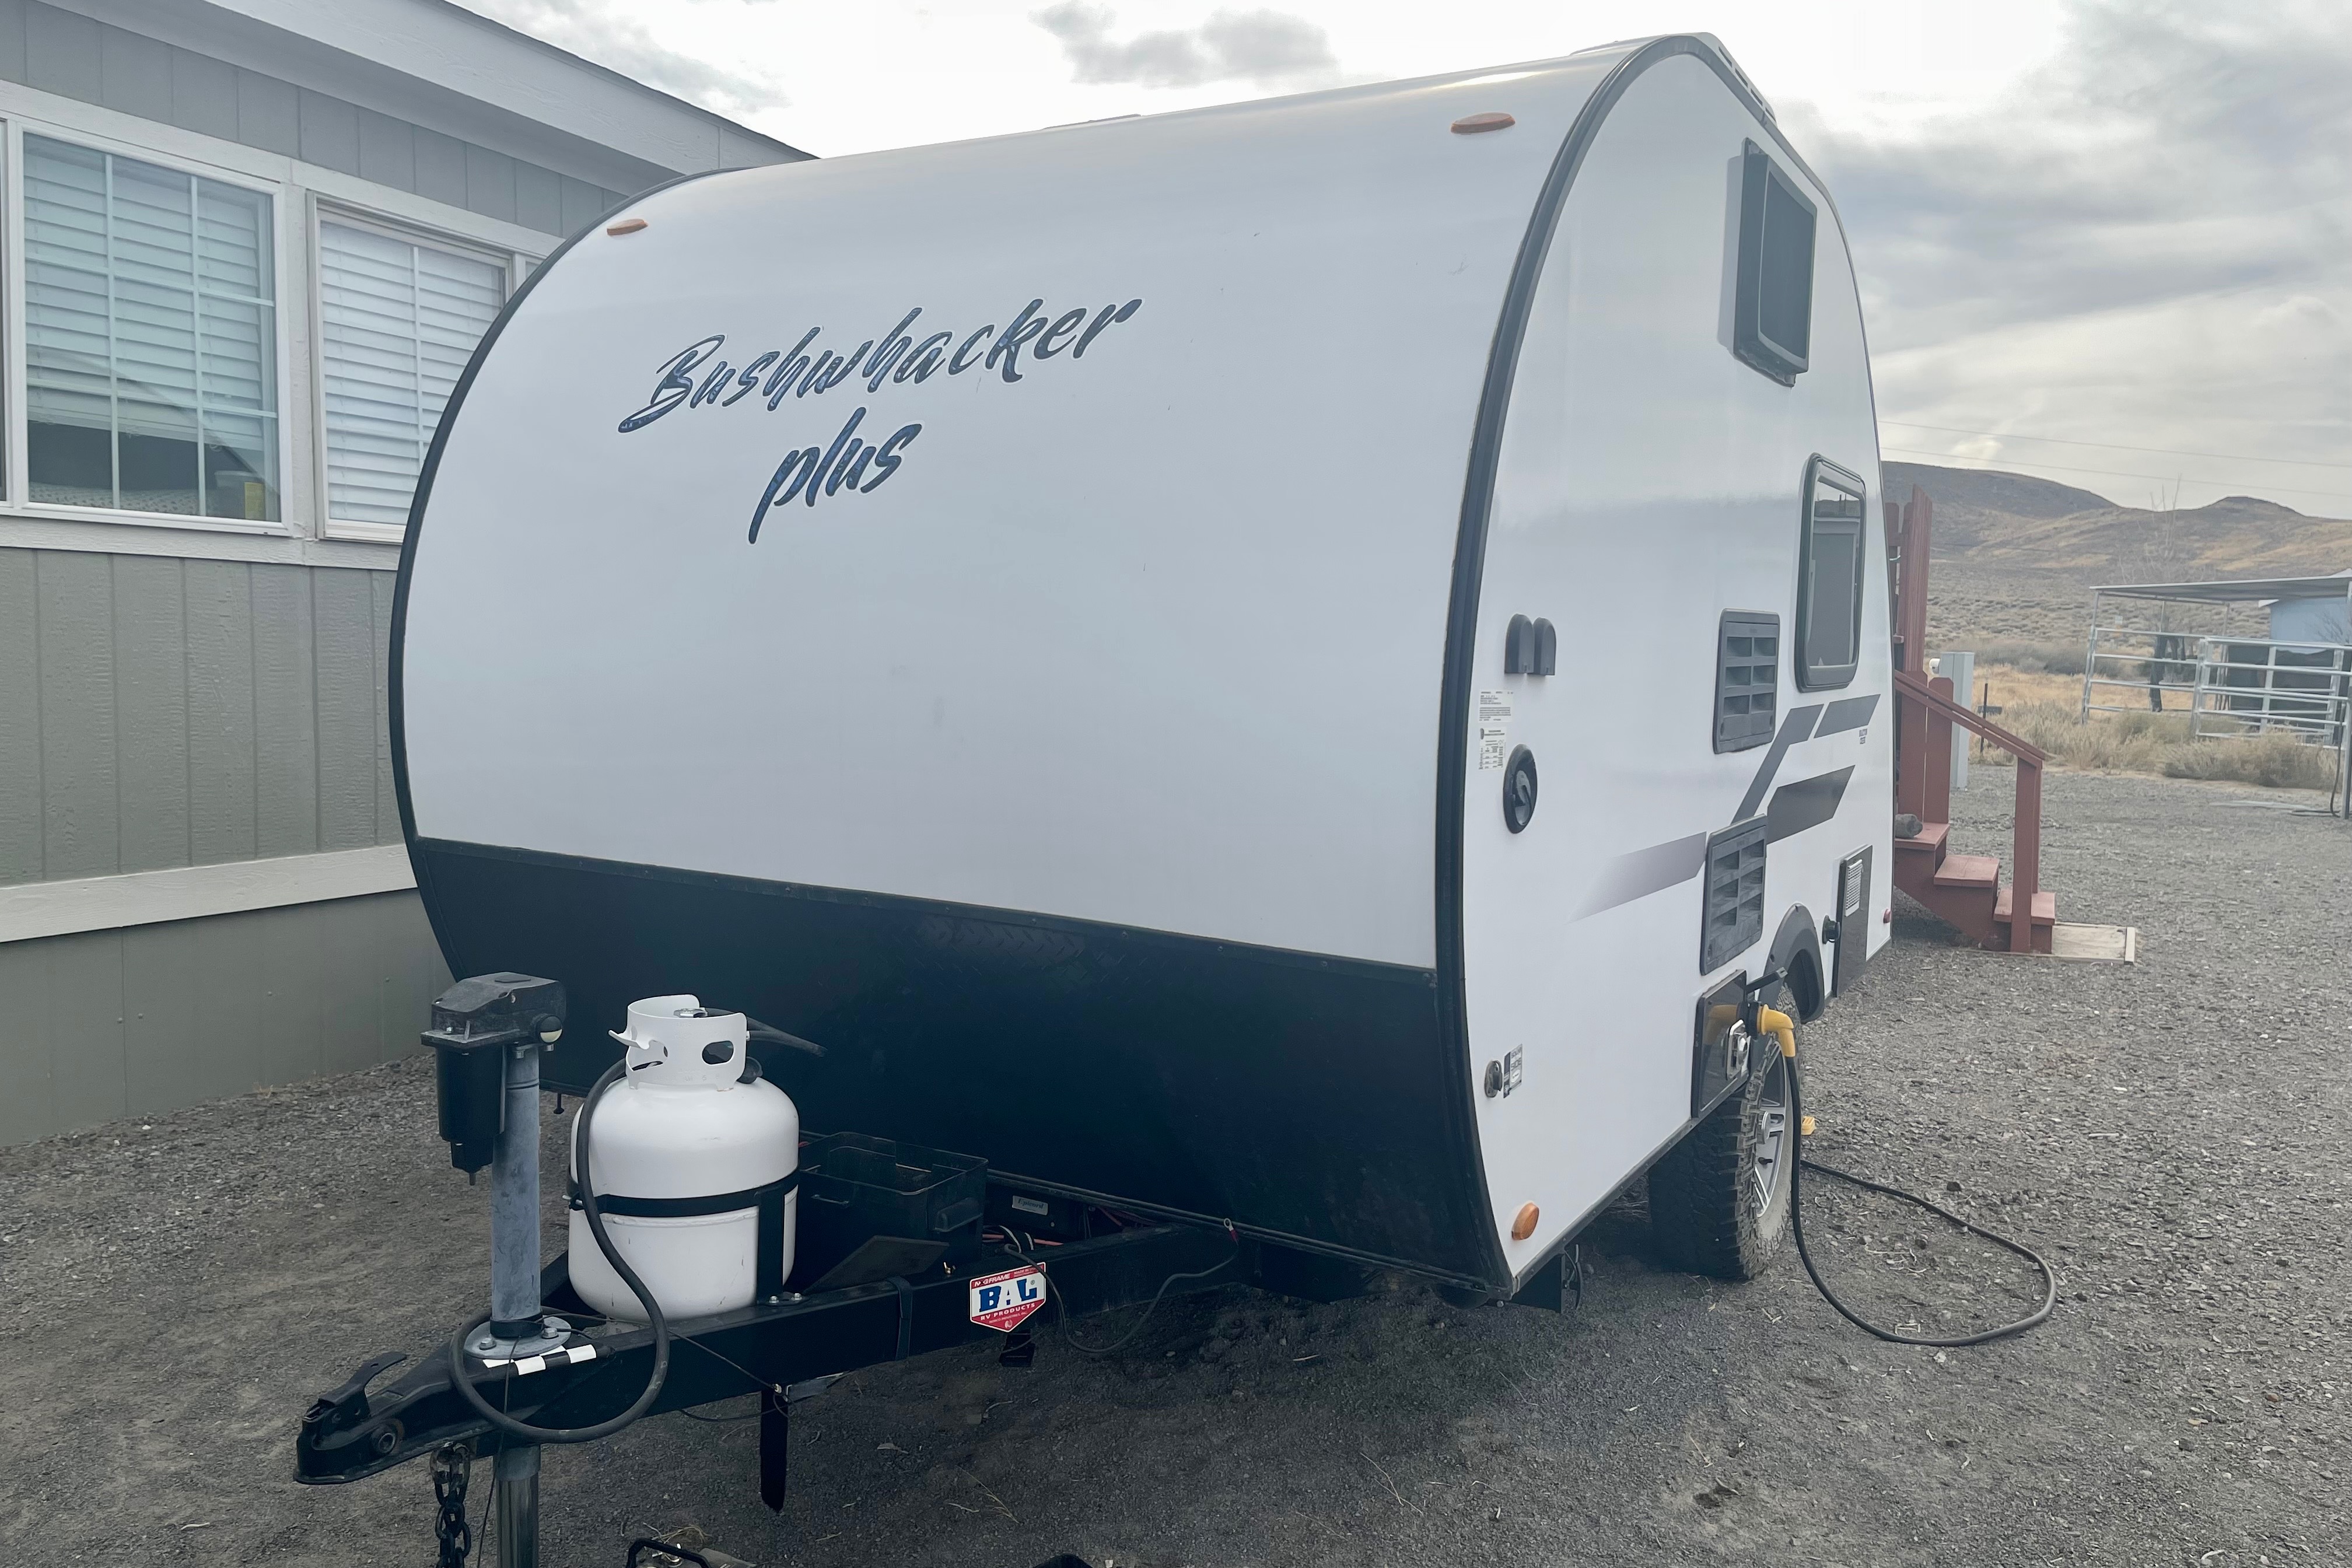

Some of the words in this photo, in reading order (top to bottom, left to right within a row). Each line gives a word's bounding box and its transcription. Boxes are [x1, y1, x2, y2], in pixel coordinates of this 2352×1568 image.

[618, 298, 1142, 433] Bushwhacker
[748, 407, 923, 544] plus
[979, 1278, 1037, 1312] BAL
[993, 1303, 1035, 1317] PRODUCTS
